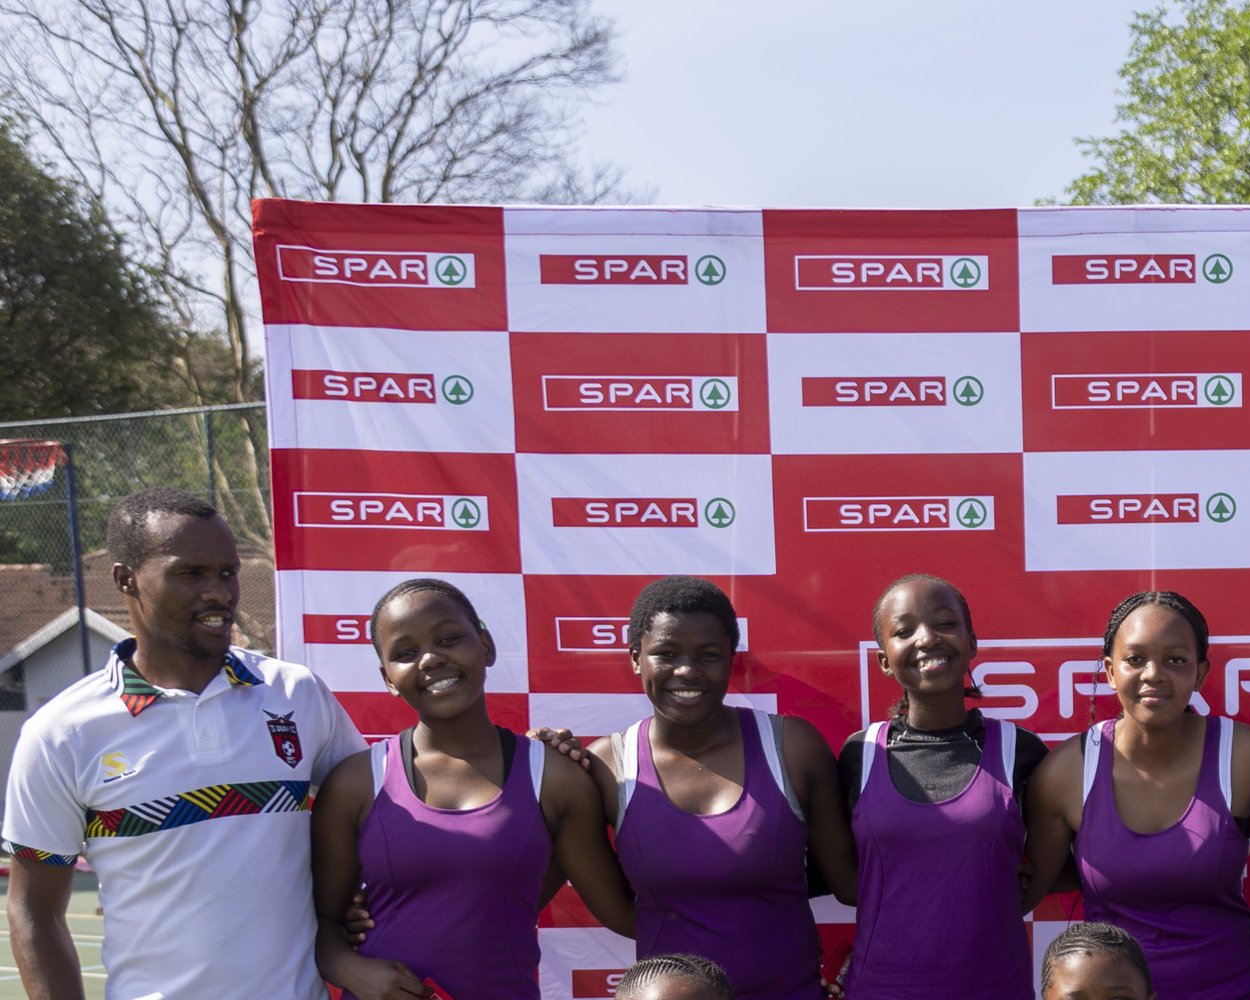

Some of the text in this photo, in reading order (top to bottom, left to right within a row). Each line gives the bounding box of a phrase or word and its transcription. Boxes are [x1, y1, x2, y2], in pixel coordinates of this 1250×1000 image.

[314, 255, 426, 280] SPAR
[574, 259, 686, 280] SPAR
[832, 262, 941, 284] SPAR
[1086, 258, 1193, 280] SPAR
[323, 375, 433, 398] SPAR
[579, 382, 690, 404] SPAR
[835, 381, 944, 402] SPAR
[1087, 380, 1195, 401] SPAR
[330, 499, 442, 522] SPAR
[585, 502, 696, 523] SPAR
[839, 503, 947, 524] SPAR
[1090, 498, 1197, 519] SPAR
